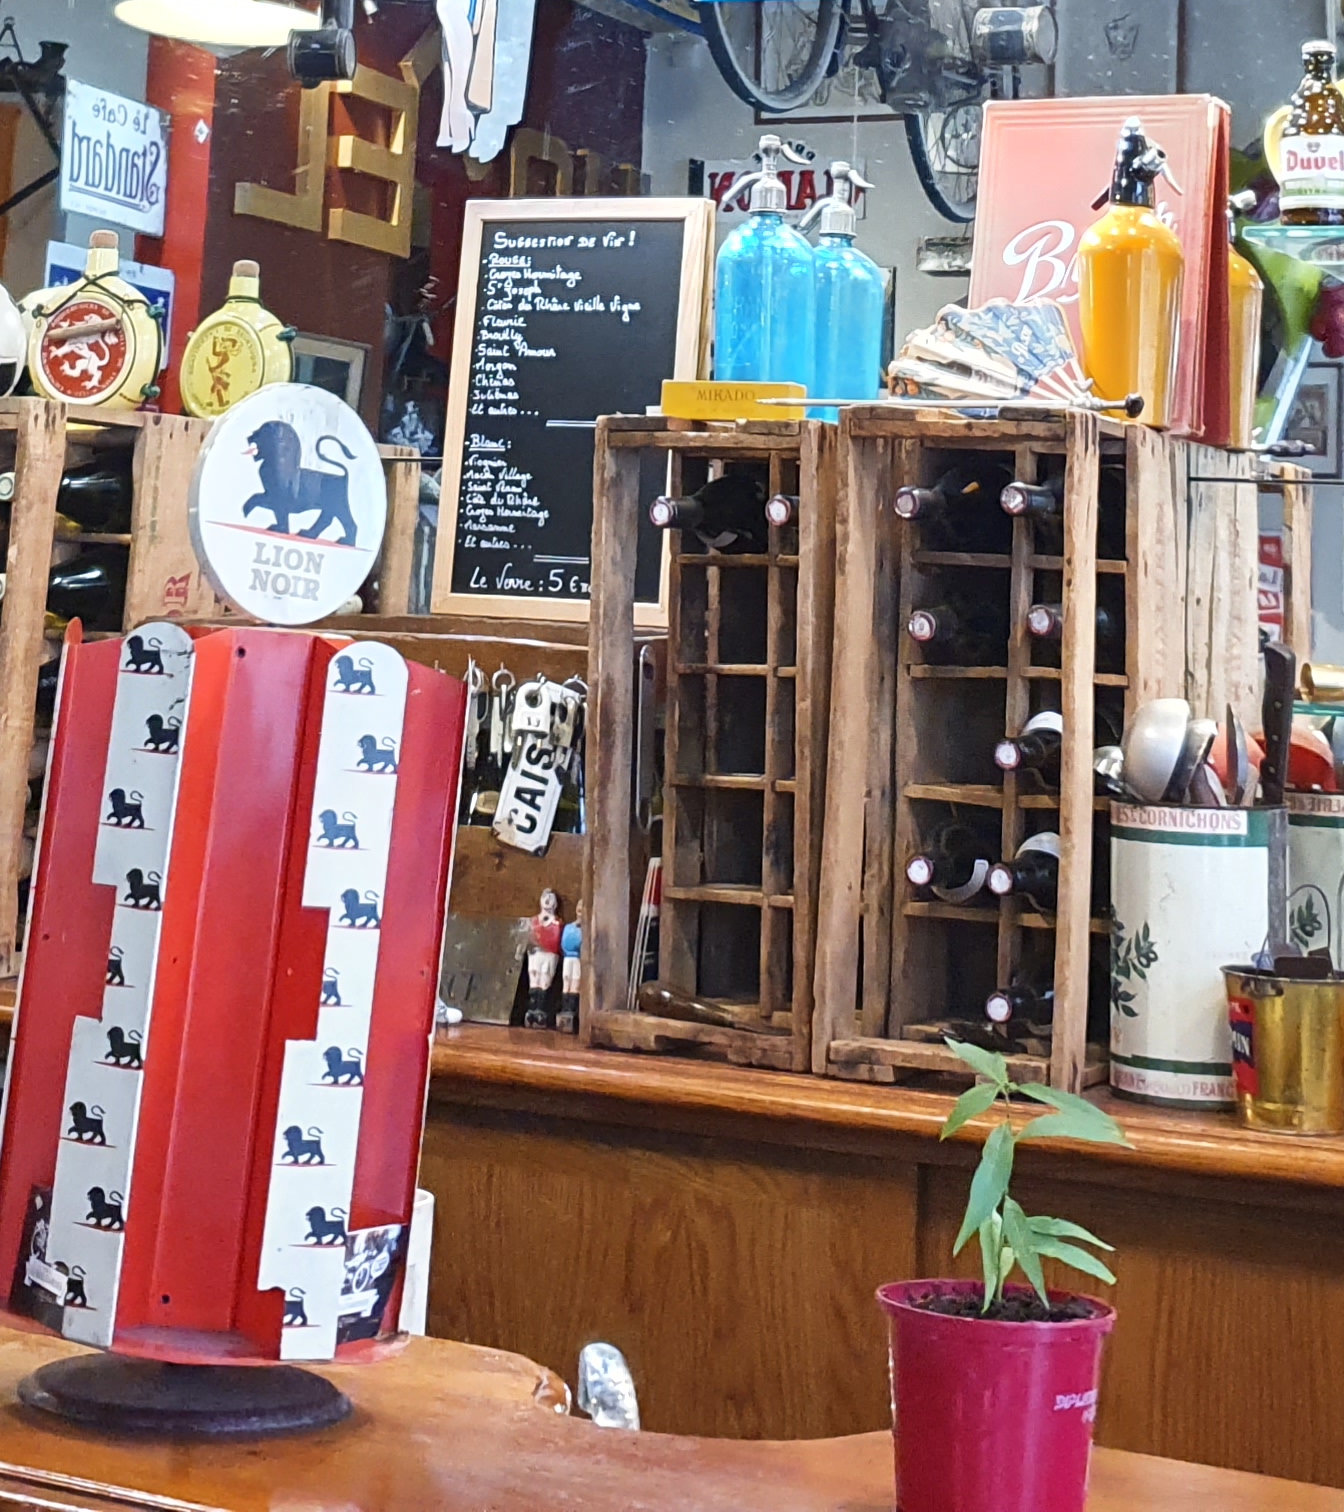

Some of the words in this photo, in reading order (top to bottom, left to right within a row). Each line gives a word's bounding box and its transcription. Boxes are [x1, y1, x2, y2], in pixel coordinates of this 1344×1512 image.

[1286, 149, 1344, 172] Duvel
[696, 389, 755, 402] MIKADO
[254, 545, 325, 575] LION
[250, 571, 320, 602] NOIR
[548, 569, 564, 591] 5
[1139, 809, 1242, 832] CORNICHONS
